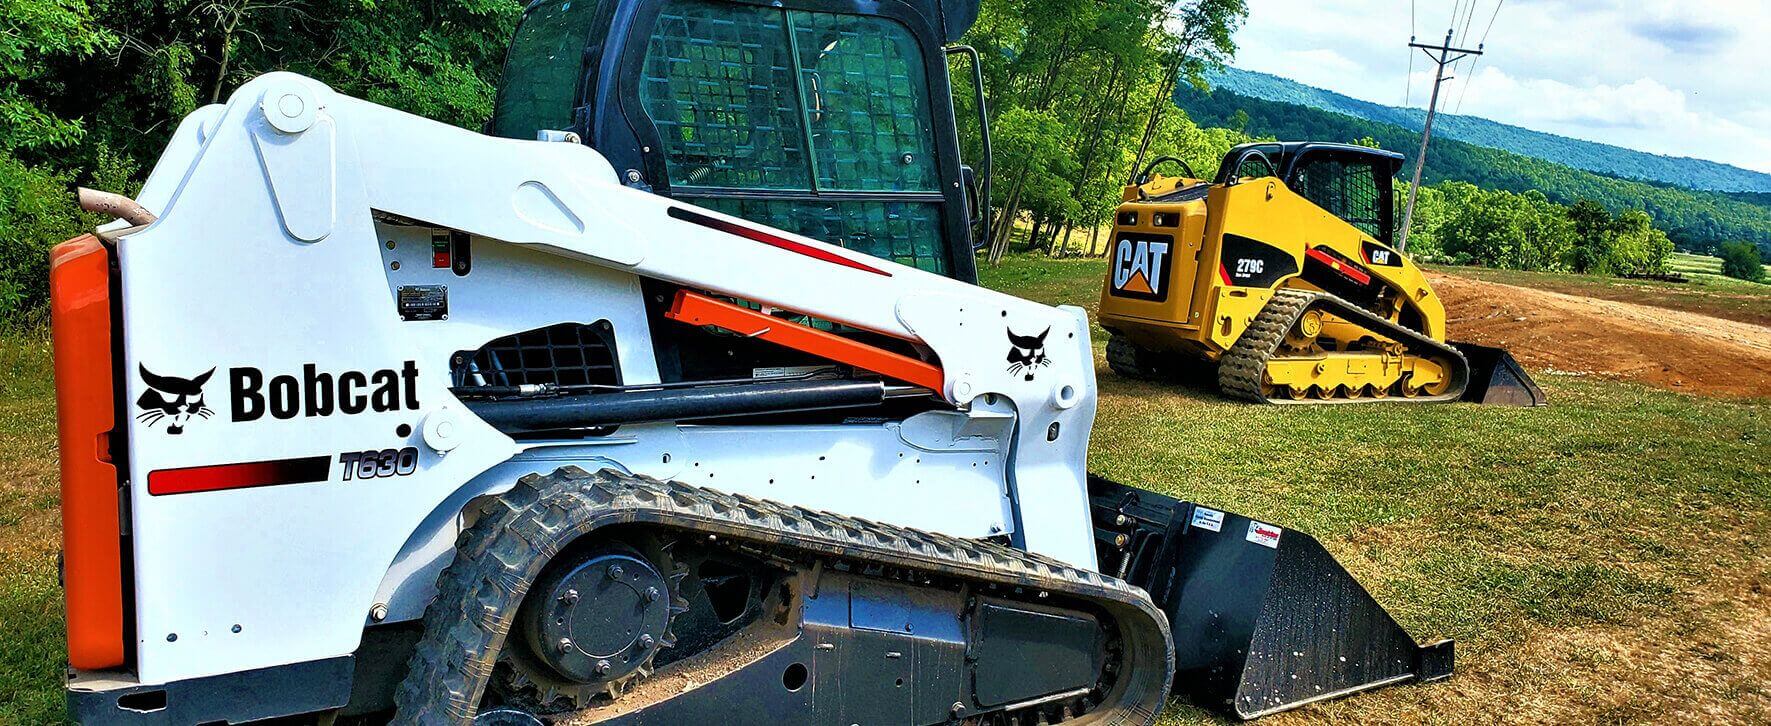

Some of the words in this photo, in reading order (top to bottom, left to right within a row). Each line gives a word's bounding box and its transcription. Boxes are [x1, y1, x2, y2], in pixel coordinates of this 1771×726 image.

[1114, 239, 1169, 295] CAT
[1236, 258, 1265, 274] 279C
[1372, 249, 1391, 265] CAT
[229, 360, 420, 423] Bobcat
[339, 446, 419, 482] T630
